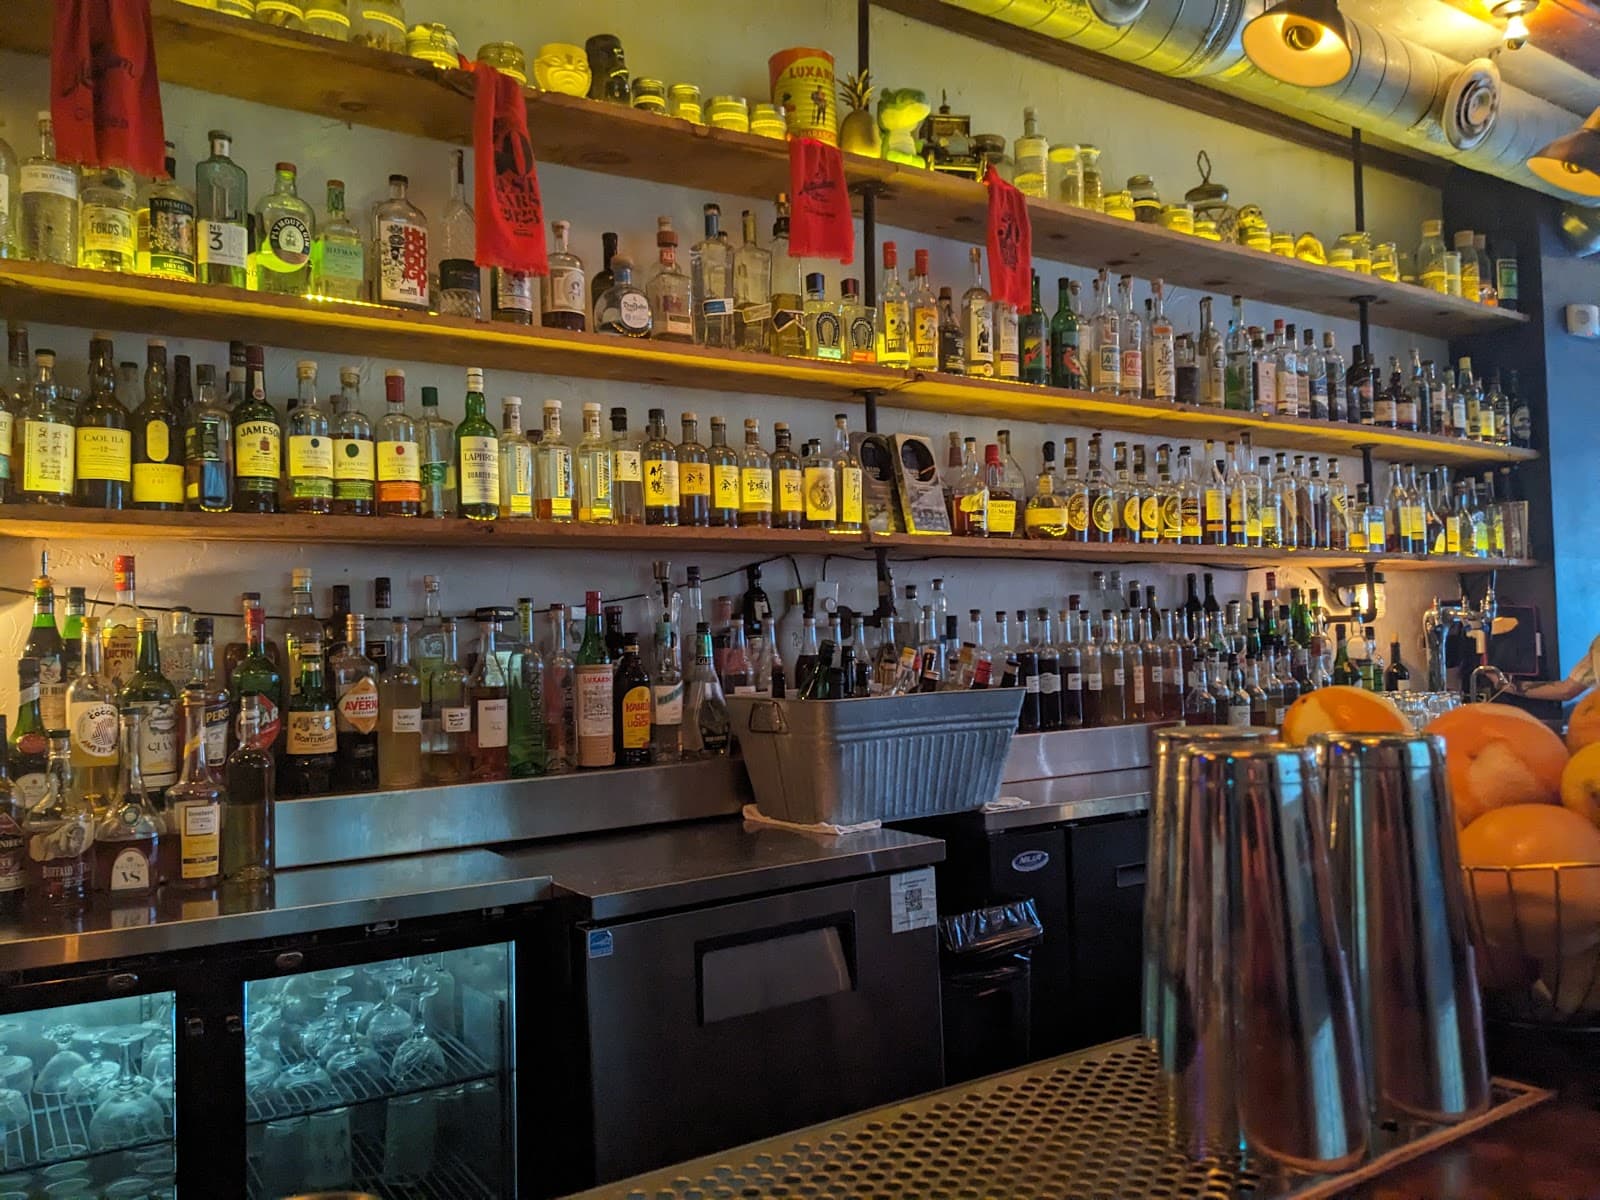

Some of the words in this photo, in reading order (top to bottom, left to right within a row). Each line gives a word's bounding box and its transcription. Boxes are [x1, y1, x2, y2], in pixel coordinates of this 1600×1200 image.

[790, 67, 836, 79] LUXAR
[209, 231, 223, 251] 3
[240, 424, 279, 438] JAMESO
[84, 434, 108, 443] CAOL
[111, 435, 125, 444] ILA
[464, 453, 497, 463] LAPHRO
[344, 699, 378, 711] AVERN
[120, 870, 141, 884] VS
